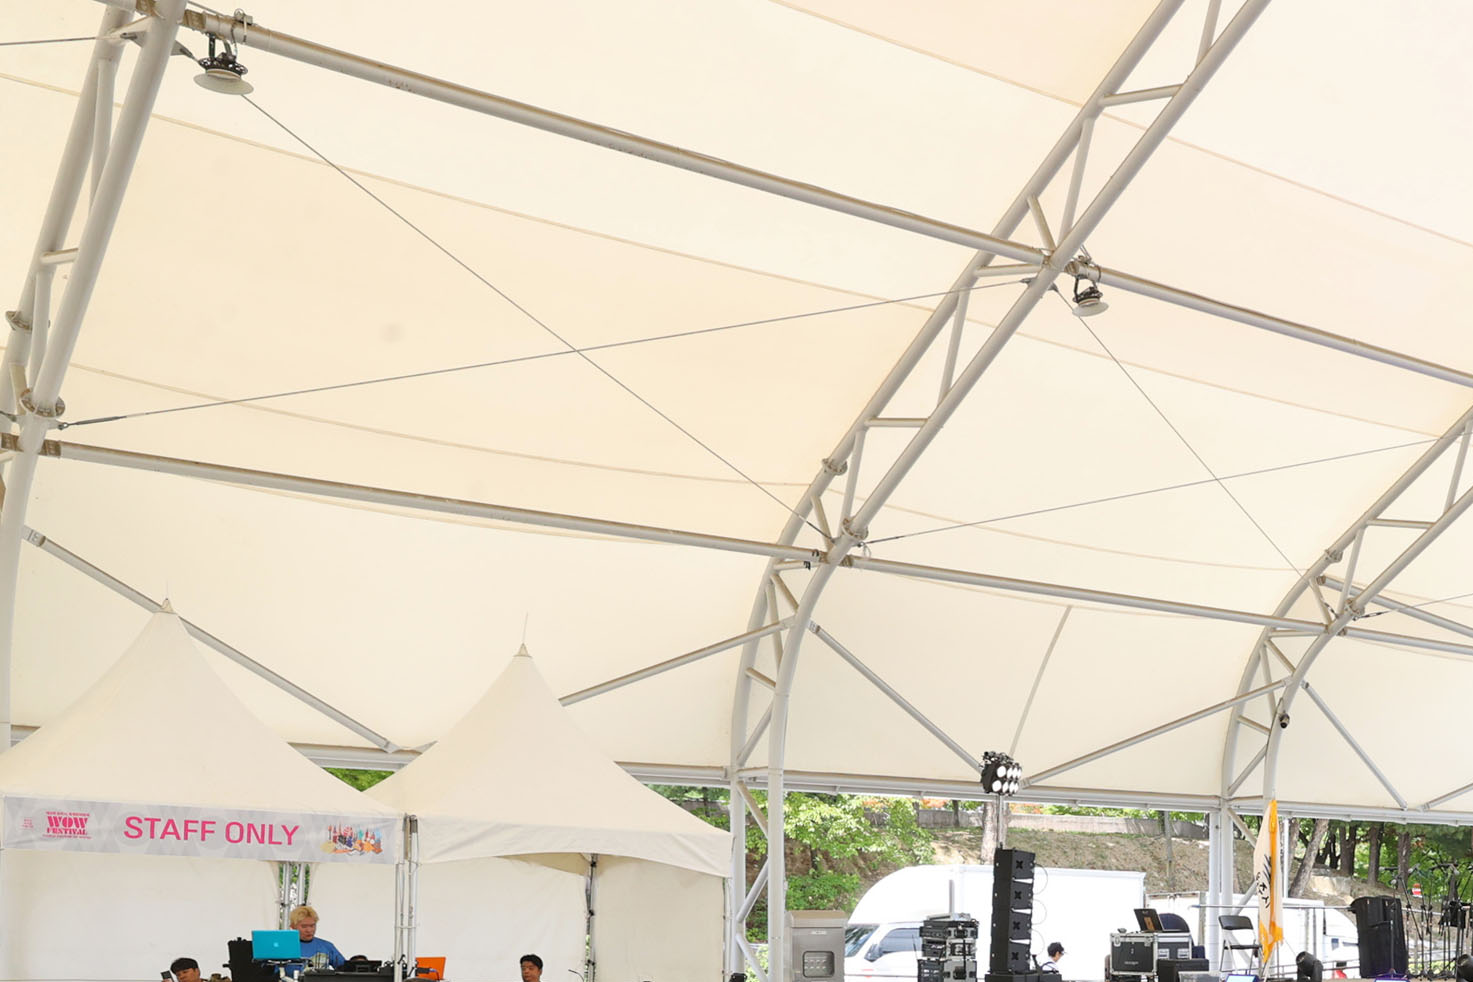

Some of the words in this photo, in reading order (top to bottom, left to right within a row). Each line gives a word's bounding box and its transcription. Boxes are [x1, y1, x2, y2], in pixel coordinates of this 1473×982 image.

[47, 815, 88, 829] WOW
[47, 827, 88, 836] FESTIVAL
[123, 816, 216, 842] STAFF
[225, 821, 300, 846] ONLY
